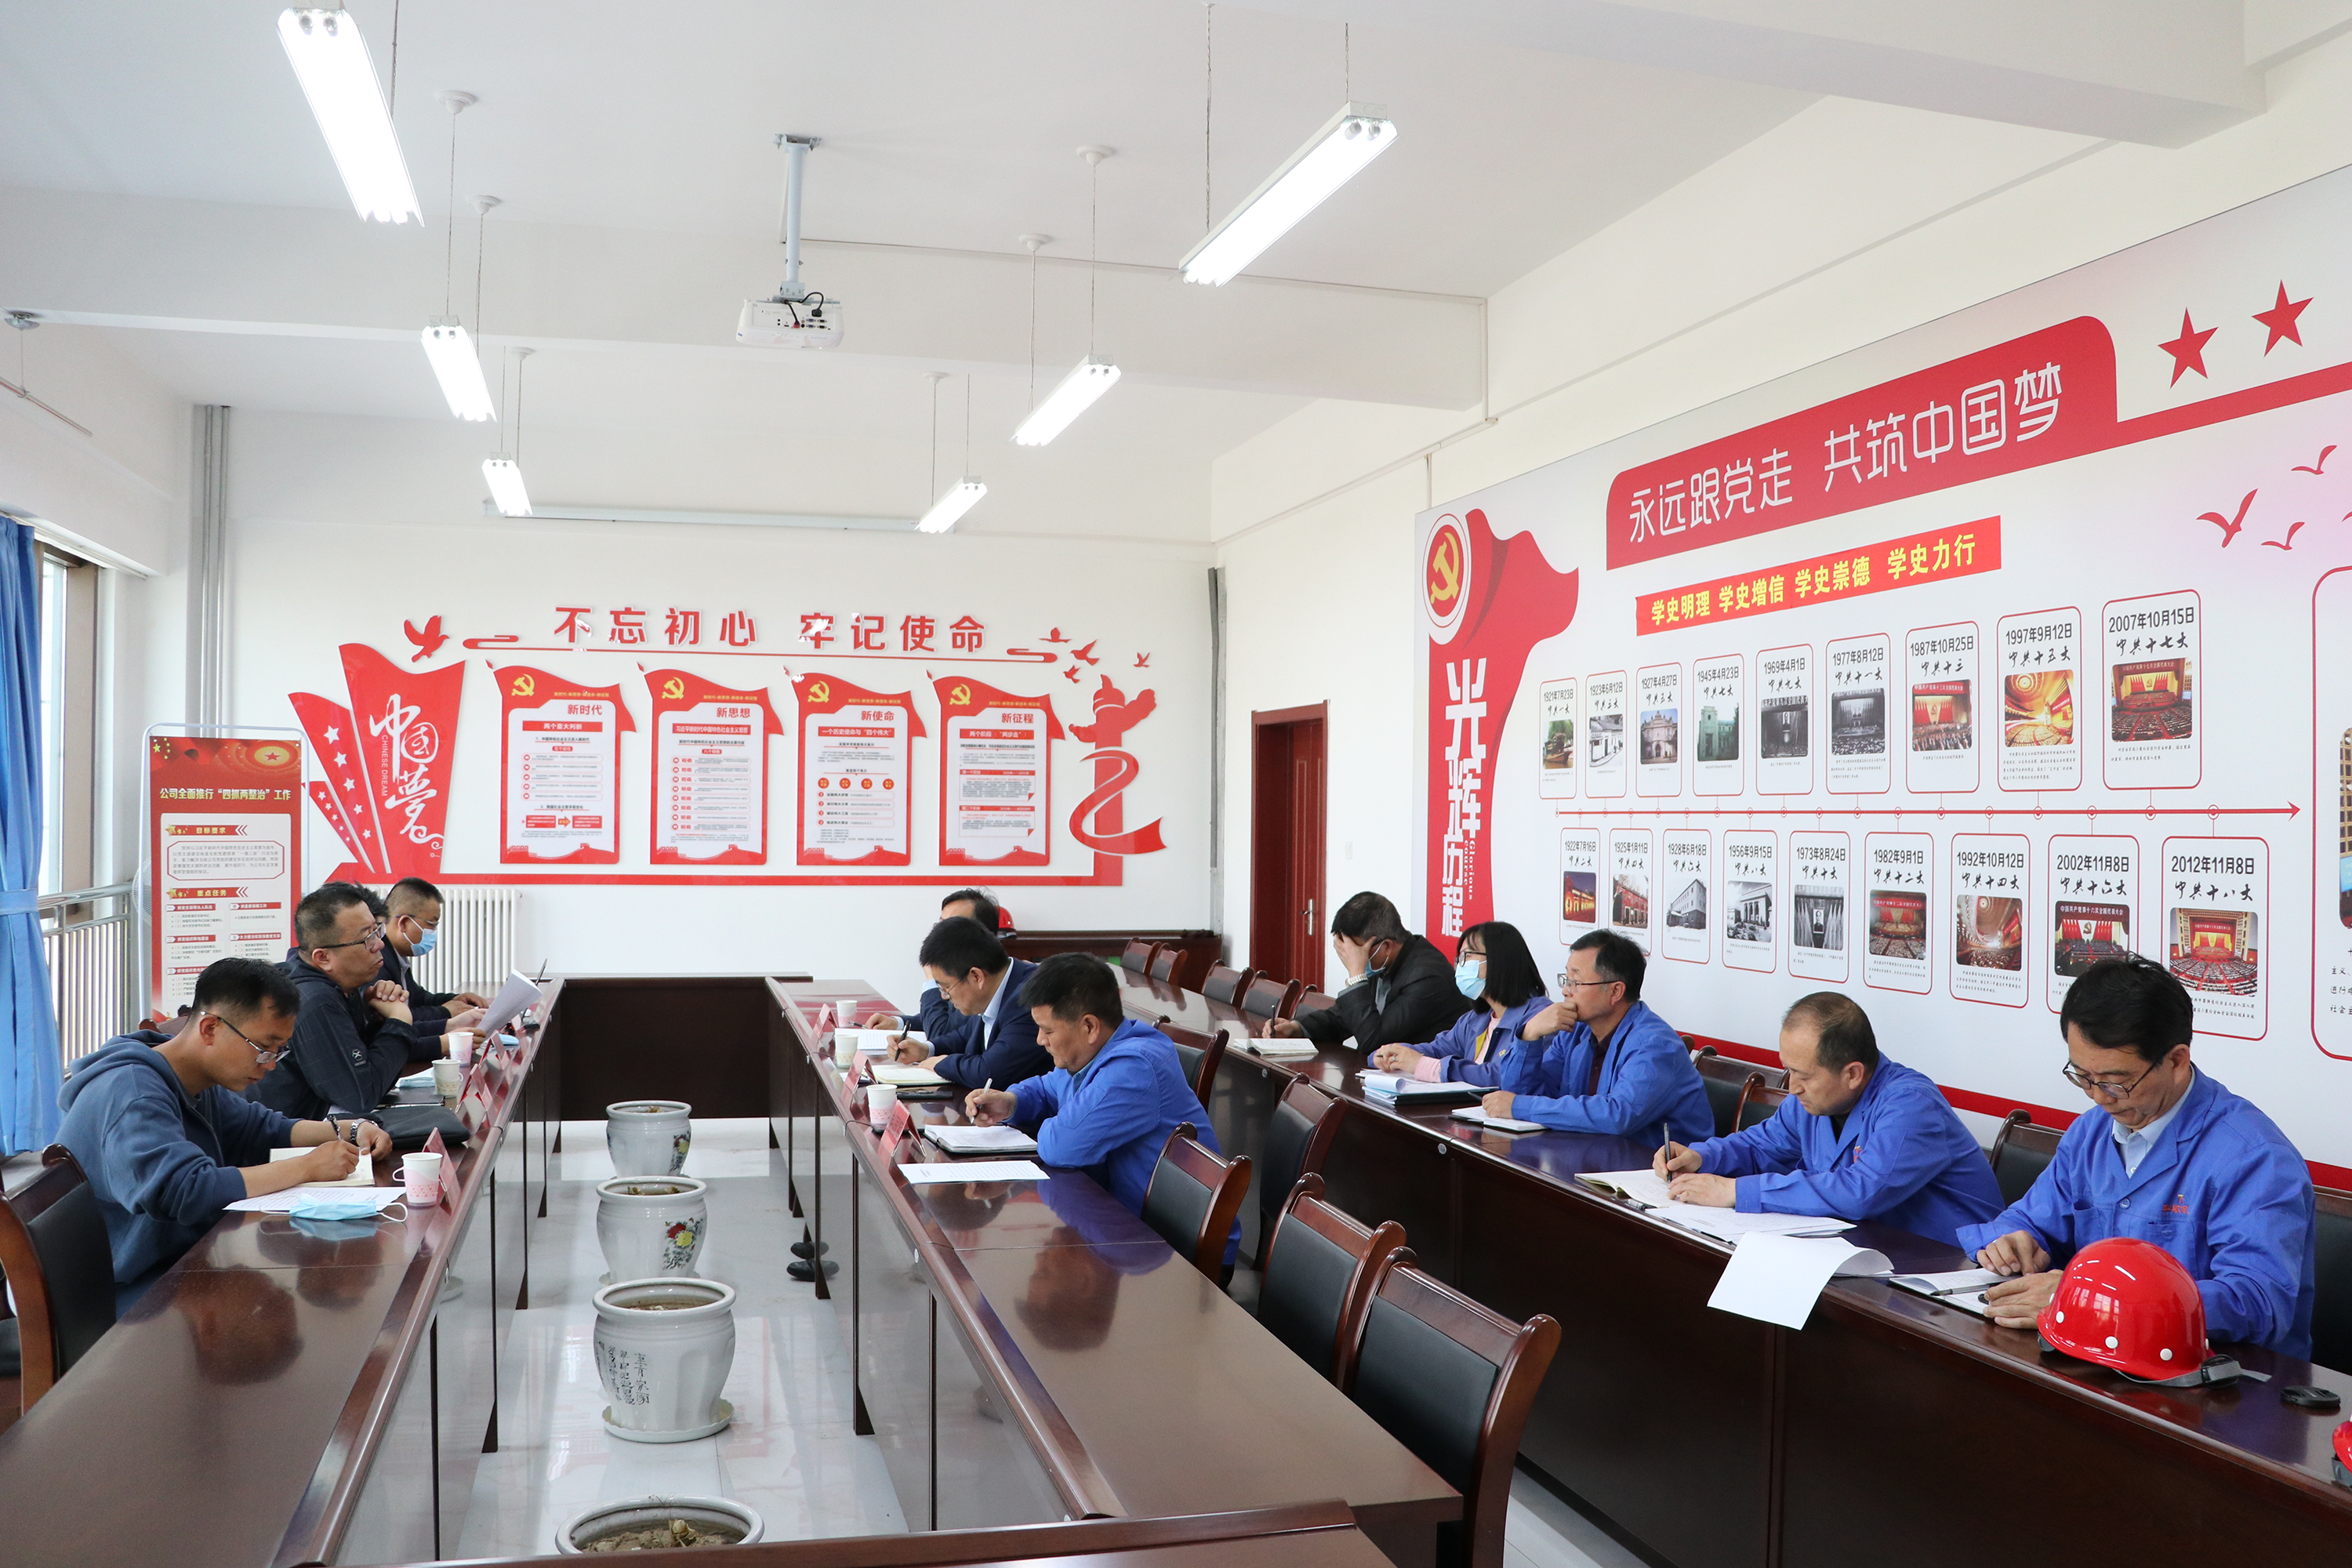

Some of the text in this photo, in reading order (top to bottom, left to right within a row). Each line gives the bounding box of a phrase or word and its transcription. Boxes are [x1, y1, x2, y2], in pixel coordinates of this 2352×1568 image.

[1629, 361, 2063, 543] 永远跟党走 共筑中国梦
[1651, 533, 1976, 626] 学史明理 学史增信 学史崇德 学史力行
[2108, 607, 2194, 633] 2007年10月15日
[554, 606, 986, 654] 不忘初心 牢记使命
[2005, 623, 2073, 645] 1997年9月12日
[1910, 635, 1974, 657] 1987年10月25日
[1832, 647, 1884, 666] 1977年8月12日
[1763, 657, 1806, 675] 1969年4月1日
[1641, 674, 1677, 689] 1927年4月27日
[1697, 666, 1739, 683] 1945年4月23日
[1543, 688, 1573, 702] 1921年7月23日
[1589, 681, 1624, 696] 1923年6月12日
[567, 704, 603, 715] 新时代
[716, 707, 751, 718] 新思想
[861, 710, 895, 721] 新使命
[1001, 713, 1034, 724] 新征程
[543, 722, 583, 731] 两个重大判断
[676, 725, 748, 734] 习近平新时代中国特色社会主义思想
[159, 788, 292, 800] 公司全面推行“四抓两整治”工作
[1442, 658, 1487, 938] 光辉历程
[1564, 840, 1596, 852] 1922年7月16日
[1613, 842, 1648, 854] 1925年1月11日
[1668, 844, 1707, 856] 1928年6月18日
[1729, 845, 1773, 858] 1956年9月15日
[1796, 847, 1846, 861] 1973年8月24日
[1873, 849, 1924, 865] 1982年9月1日
[1956, 851, 2024, 869] 1992年10月12日
[2056, 855, 2129, 873] 2002年11月8日
[2171, 855, 2255, 875] 2012年11月8日
